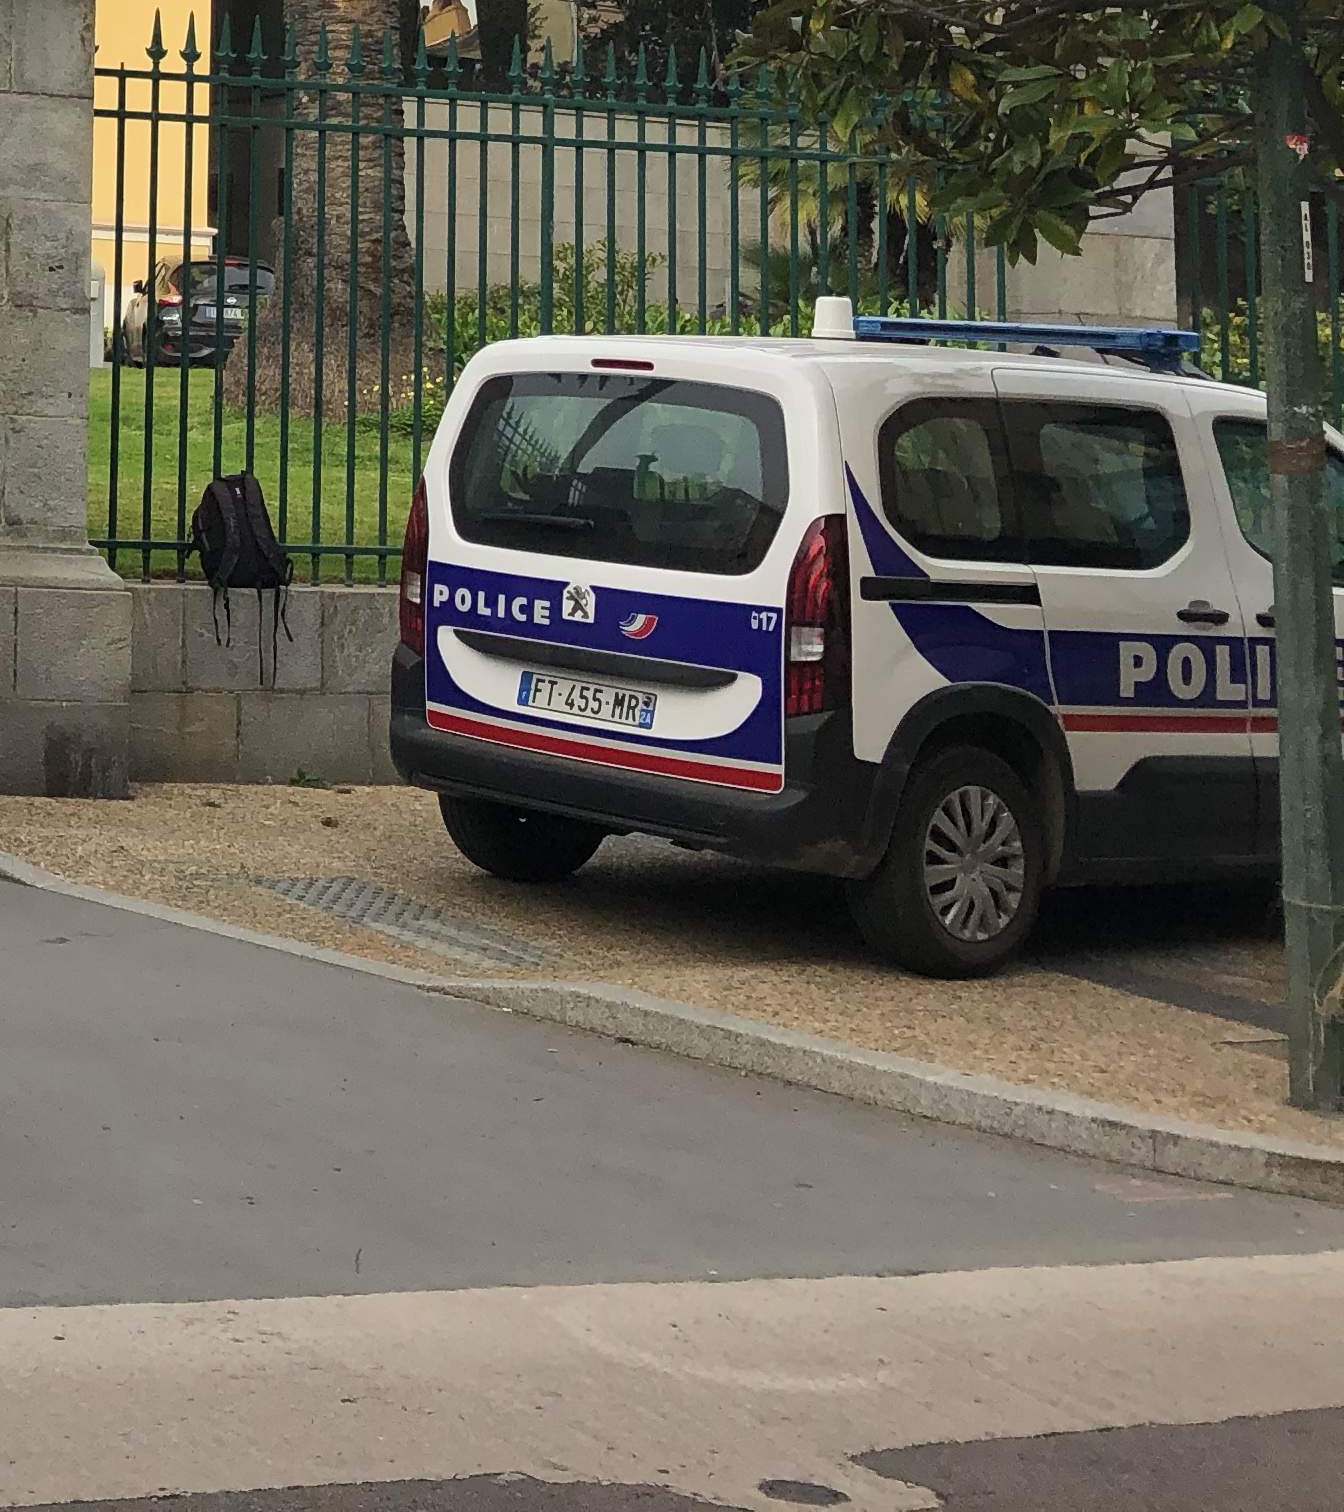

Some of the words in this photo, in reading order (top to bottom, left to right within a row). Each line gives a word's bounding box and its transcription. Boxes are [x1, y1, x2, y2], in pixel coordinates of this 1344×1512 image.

[433, 583, 551, 626] POLICE
[759, 611, 778, 632] 17
[1119, 640, 1344, 701] POLI
[639, 710, 652, 725] 2A
